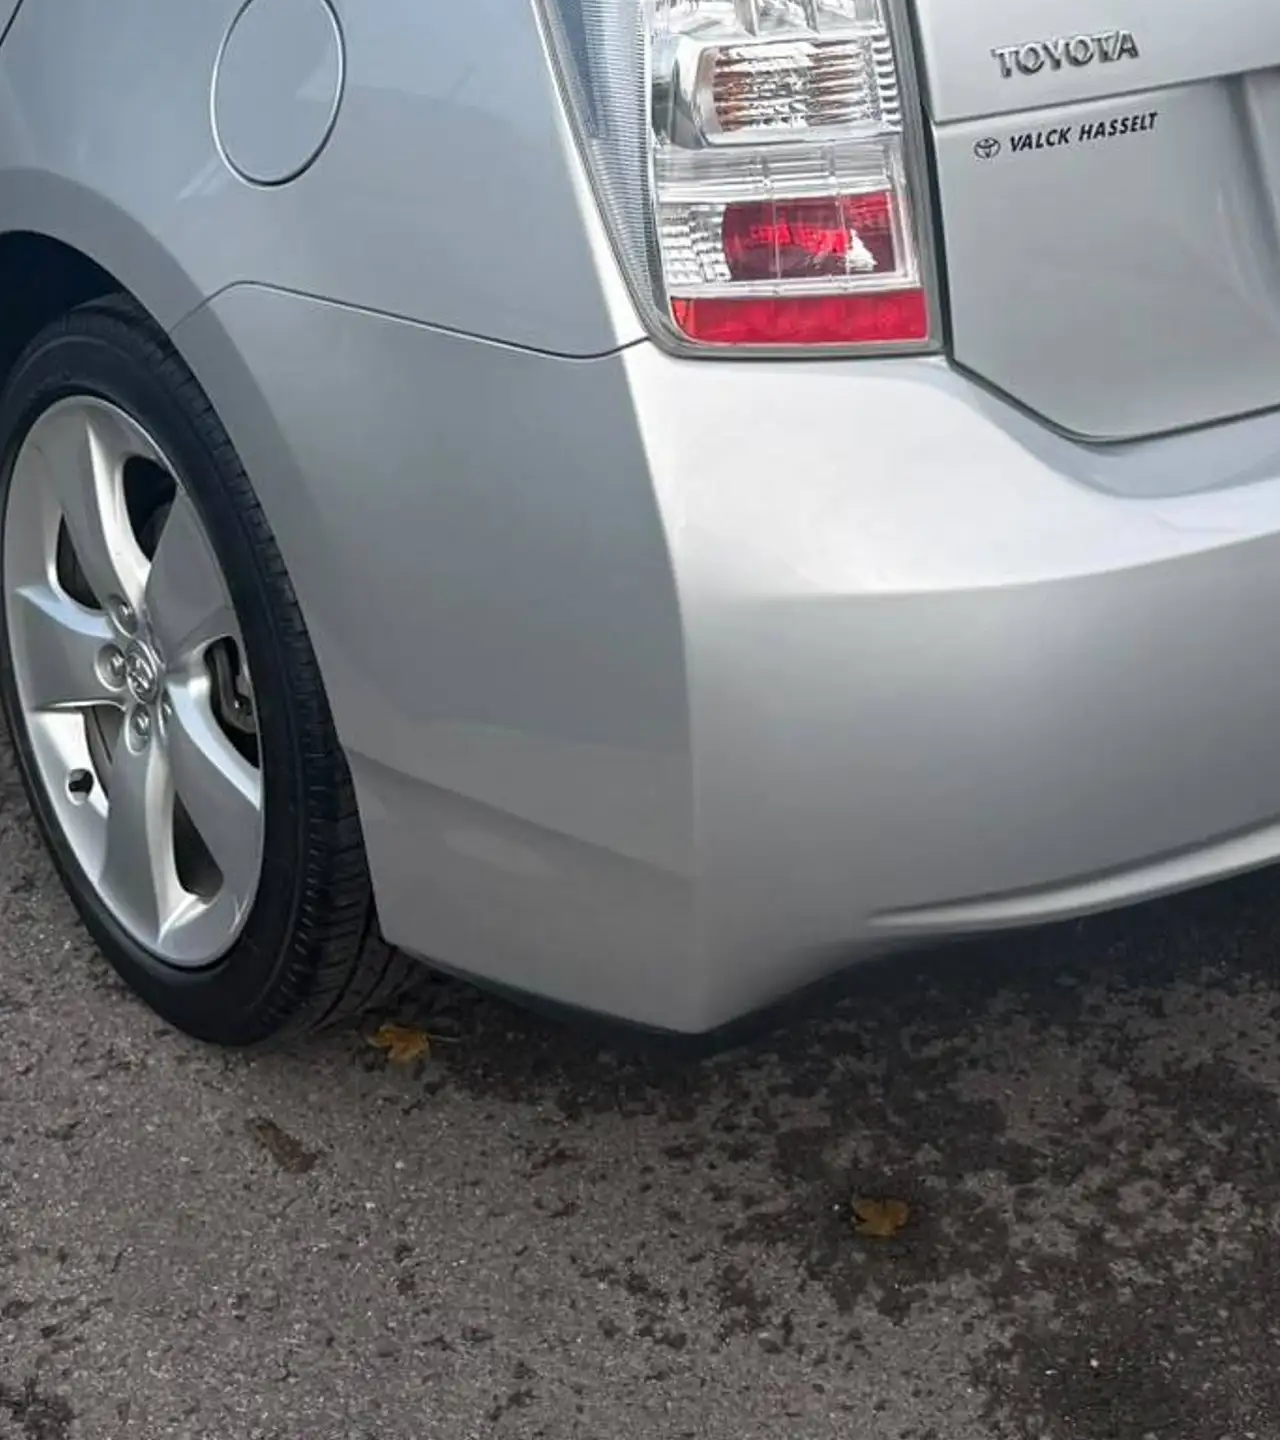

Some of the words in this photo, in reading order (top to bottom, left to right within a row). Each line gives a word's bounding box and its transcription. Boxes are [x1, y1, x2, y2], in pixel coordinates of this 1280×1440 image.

[990, 29, 1140, 79] TOYOTA
[1010, 126, 1072, 153] VALCK
[1078, 111, 1158, 142] HASSELT
